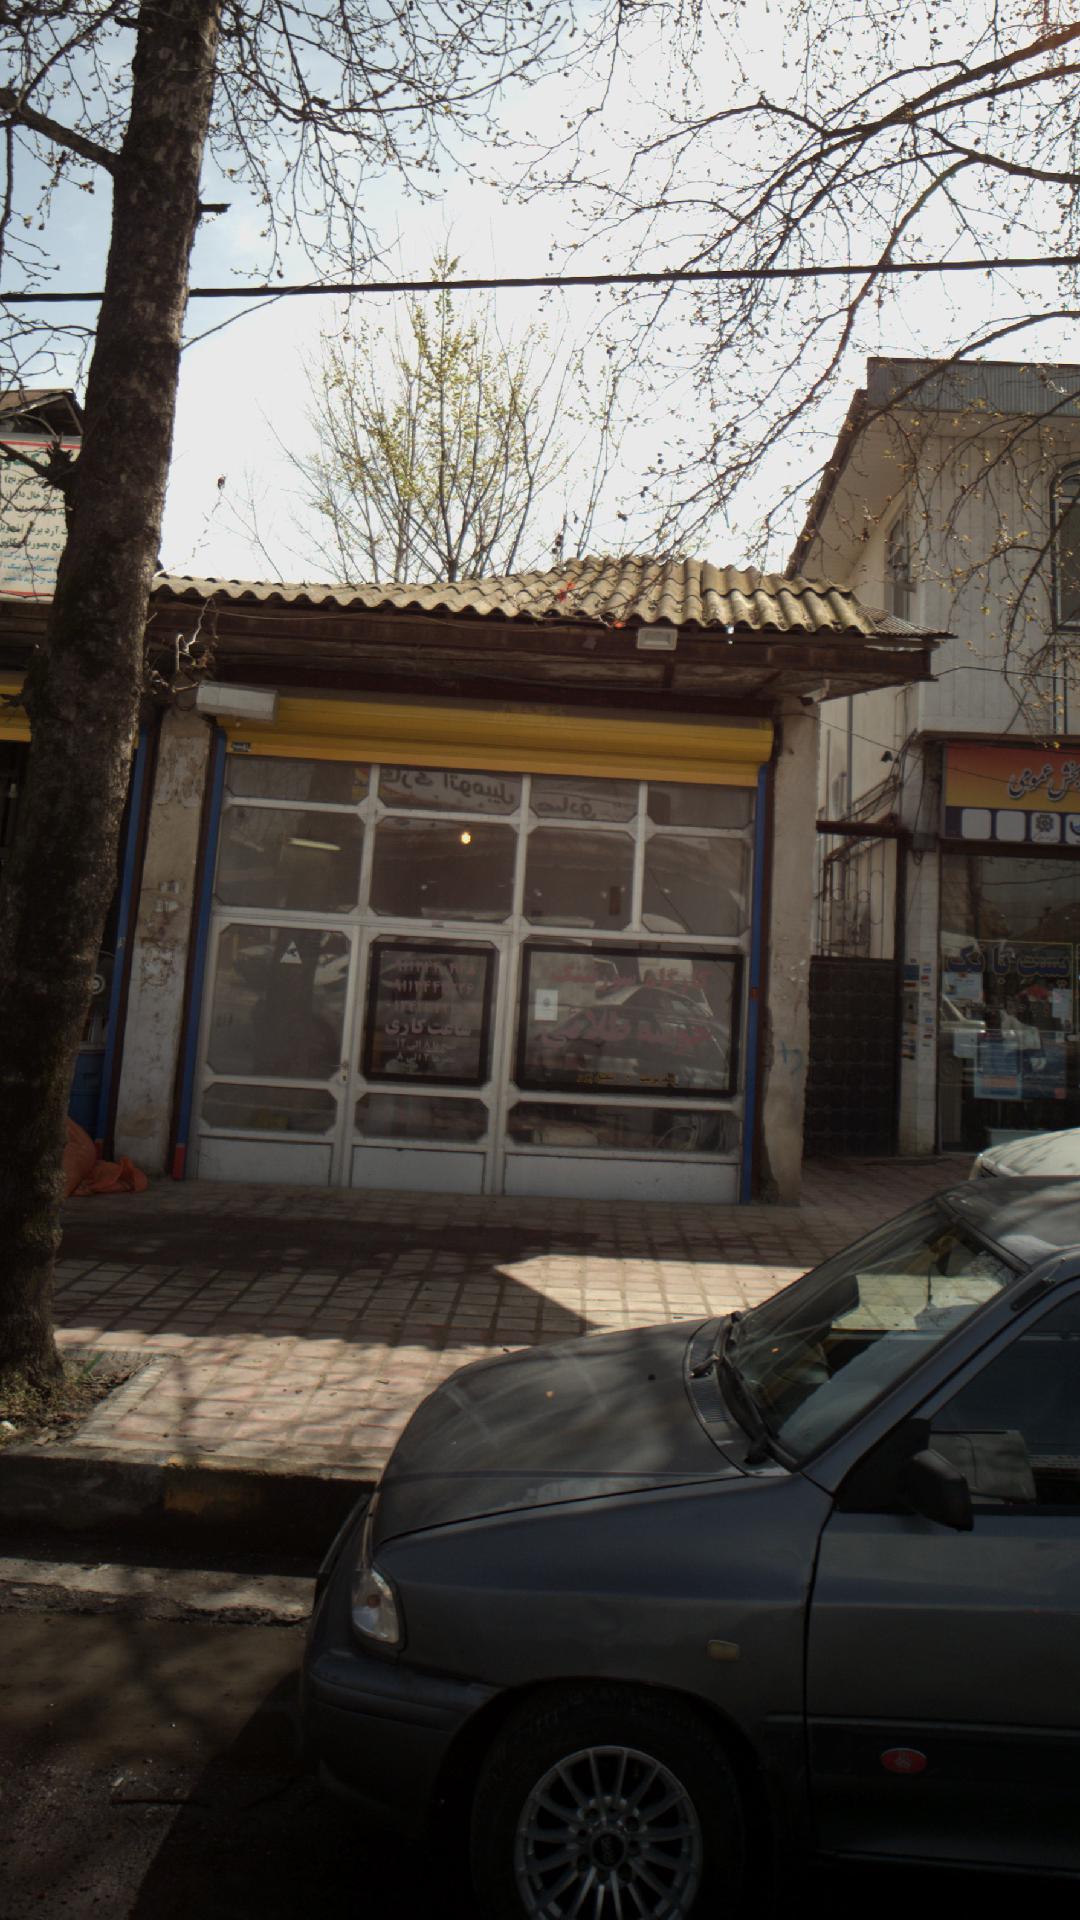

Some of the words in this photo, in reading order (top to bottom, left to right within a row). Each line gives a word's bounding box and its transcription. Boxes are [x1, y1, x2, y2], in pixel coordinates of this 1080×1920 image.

[1008, 762, 1053, 800] عمومی
[385, 1017, 426, 1036] کاری
[427, 1021, 472, 1037] ساعت
